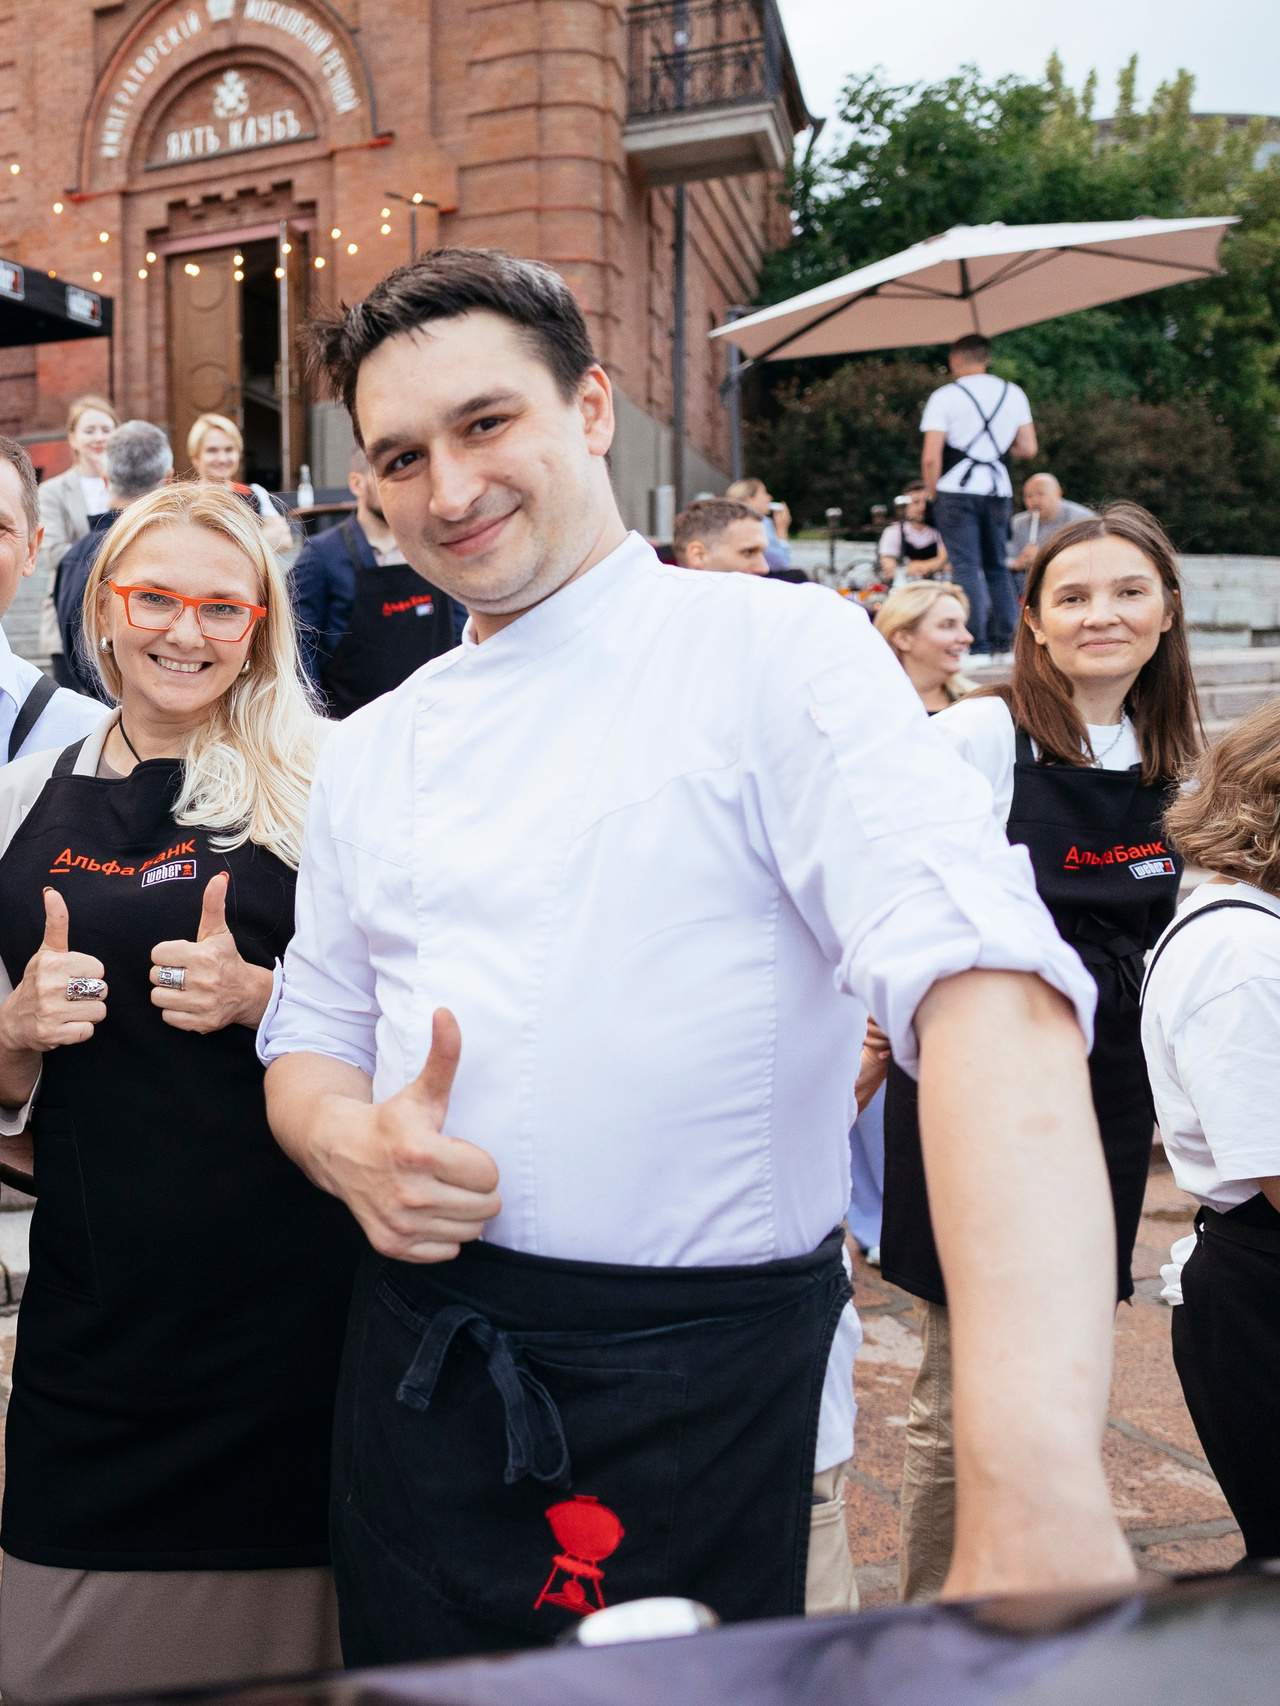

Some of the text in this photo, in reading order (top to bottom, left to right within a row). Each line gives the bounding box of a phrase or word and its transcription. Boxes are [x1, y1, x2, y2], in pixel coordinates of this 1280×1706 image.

[50, 848, 136, 876] Альфа
[1113, 841, 1167, 863] Банк
[146, 862, 182, 884] weber
